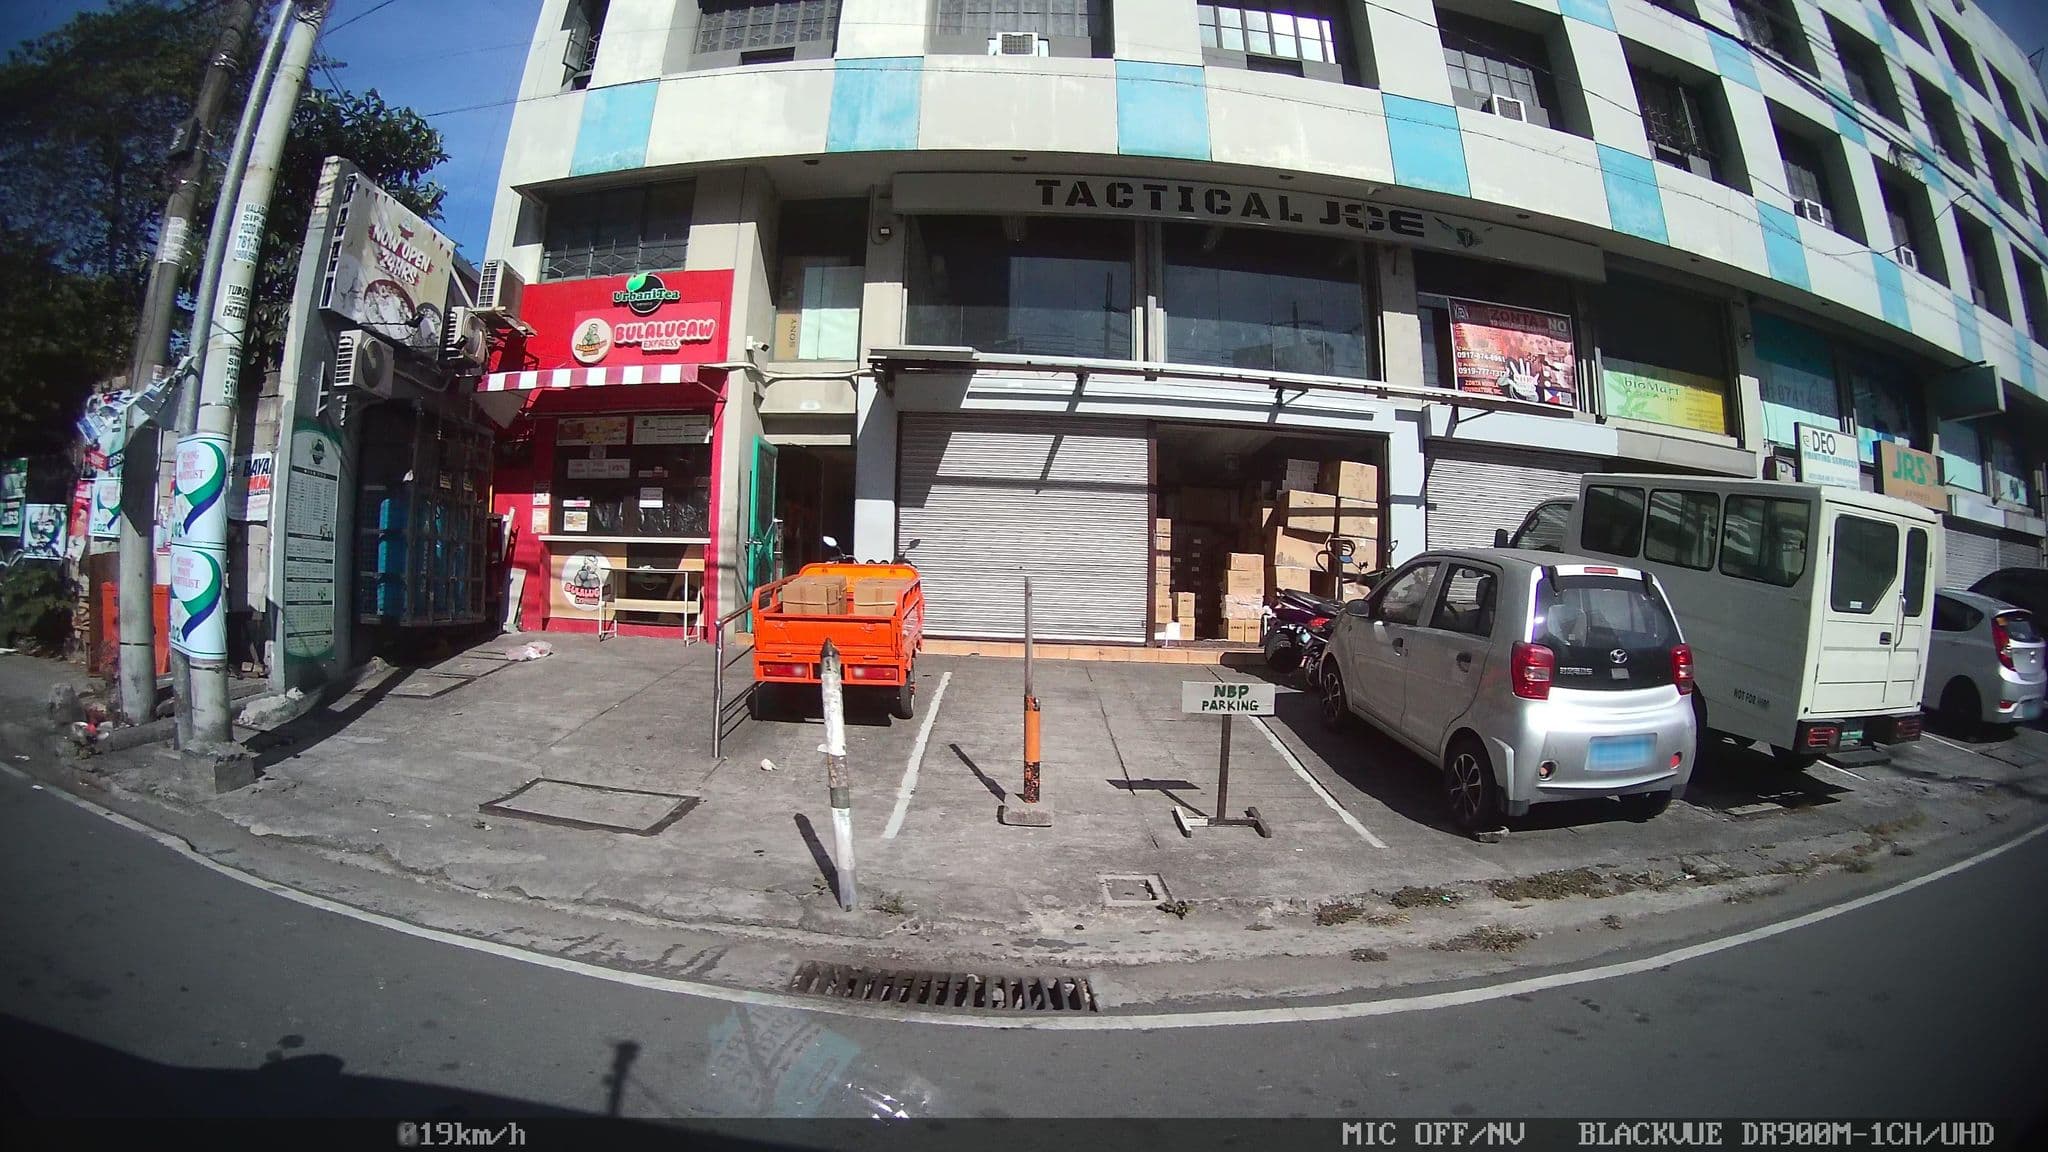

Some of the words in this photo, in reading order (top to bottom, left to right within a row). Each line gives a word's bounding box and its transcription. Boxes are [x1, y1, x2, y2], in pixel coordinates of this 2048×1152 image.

[1035, 179, 1303, 223] TACTICAL
[1319, 200, 1425, 238] JOE
[372, 224, 401, 253] NOW
[401, 239, 431, 273] OPEN
[379, 252, 418, 285] 24HRS
[614, 320, 715, 342] BULALUGAW
[1547, 316, 1568, 333] NO
[643, 339, 680, 349] EXPRESS
[1812, 430, 1836, 456] DEO
[1892, 448, 1927, 485] JRS
[1213, 684, 1250, 699] NBP
[1201, 700, 1260, 712] PARKING
